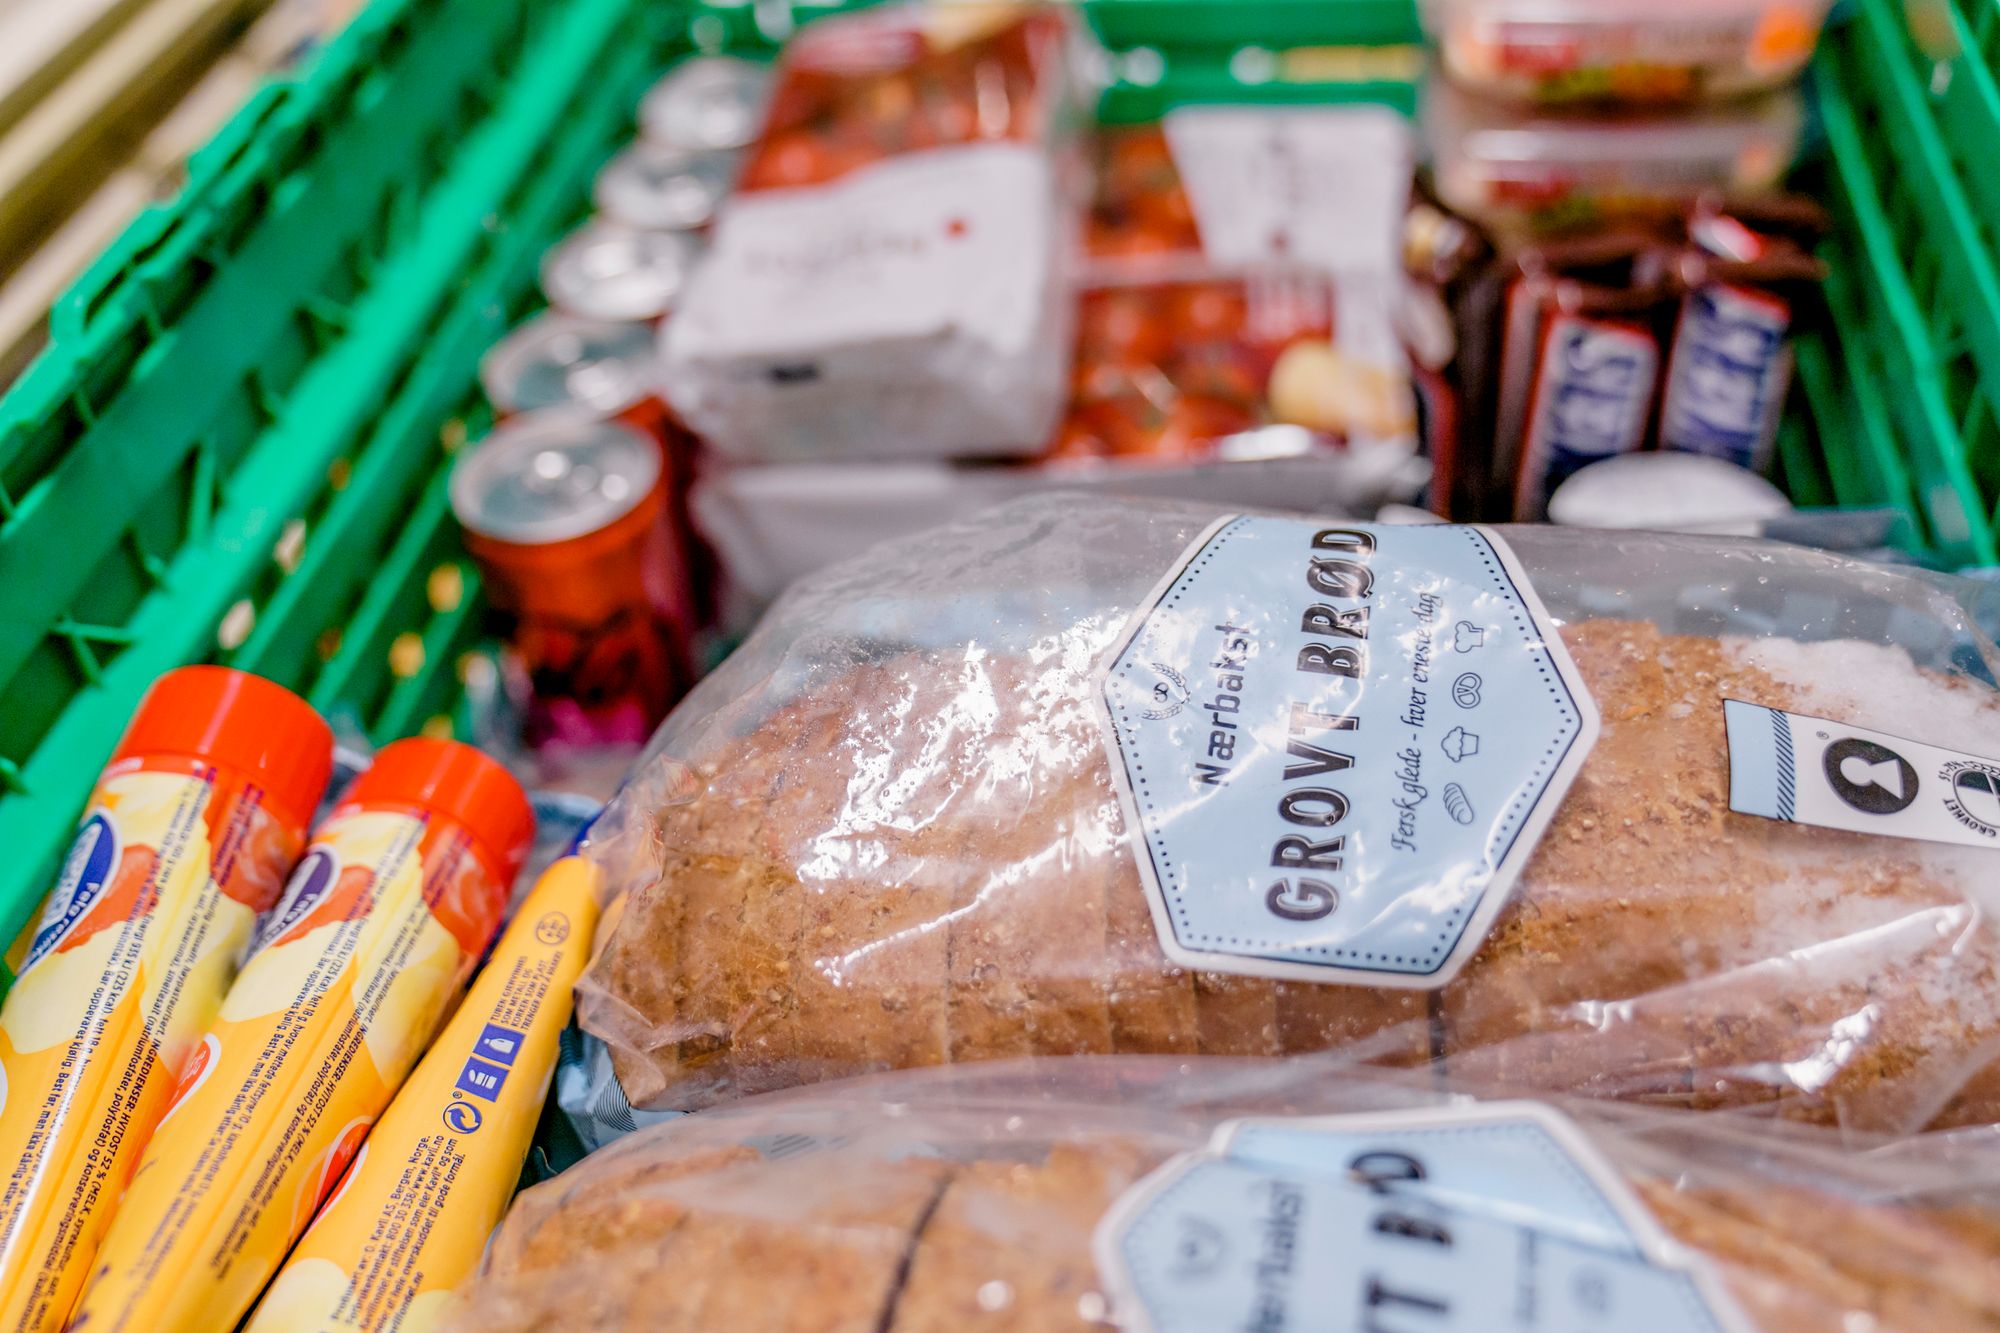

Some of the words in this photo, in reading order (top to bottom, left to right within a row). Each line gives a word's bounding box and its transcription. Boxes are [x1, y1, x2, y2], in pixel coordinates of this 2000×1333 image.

[1296, 528, 1377, 679] BRØD
[1411, 592, 1440, 625] dag
[1193, 621, 1250, 786] Nærbakst
[1401, 687, 1427, 728] hver
[1395, 748, 1428, 799] glede
[1265, 701, 1360, 921] GROVT
[1391, 798, 1420, 851] Fersk
[1942, 798, 1997, 837] GROVHET
[111, 969, 129, 992] (225
[290, 969, 319, 1011] oppbevares
[74, 986, 105, 1040] oppbevares
[302, 1005, 314, 1017] 18
[308, 993, 321, 1008] fett
[275, 1008, 295, 1033] kjølig.
[296, 1015, 306, 1024] g,
[326, 1001, 366, 1062] (natriumfosfater,
[267, 1031, 283, 1050] Best
[283, 1023, 304, 1050] hvorav
[331, 1023, 368, 1082] INGREDIENSER:
[60, 1039, 82, 1072] kjølig.
[115, 1015, 158, 1093] (natriumfosfater,
[250, 1061, 264, 1077] men
[265, 1048, 288, 1080] mettede
[52, 1071, 69, 1093] Best
[123, 1038, 163, 1112] INGREDIENSER:
[302, 1060, 333, 1105] polyfosfat)
[43, 1091, 60, 1110] før,
[296, 1103, 307, 1114] og
[311, 1080, 336, 1116] HVITOST
[35, 1110, 50, 1131] men
[93, 1093, 126, 1147] polyfosfat)
[105, 1113, 131, 1155] HVITOST
[305, 1114, 317, 1127] 52
[26, 1131, 42, 1151] ikke
[88, 1147, 101, 1161] og
[444, 1137, 458, 1155] som
[11, 1151, 33, 1180] dårlig
[96, 1170, 106, 1180] %
[100, 1156, 112, 1169] 52
[390, 1163, 416, 1201] Bergen,
[407, 1132, 431, 1165] Norge.
[438, 1154, 451, 1168] og
[442, 1150, 466, 1183] formål.
[79, 1180, 102, 1216] (MELK,
[432, 1183, 452, 1208] gode
[409, 1208, 423, 1227] som
[427, 1206, 439, 1218] til
[399, 1216, 434, 1275] overskuddet
